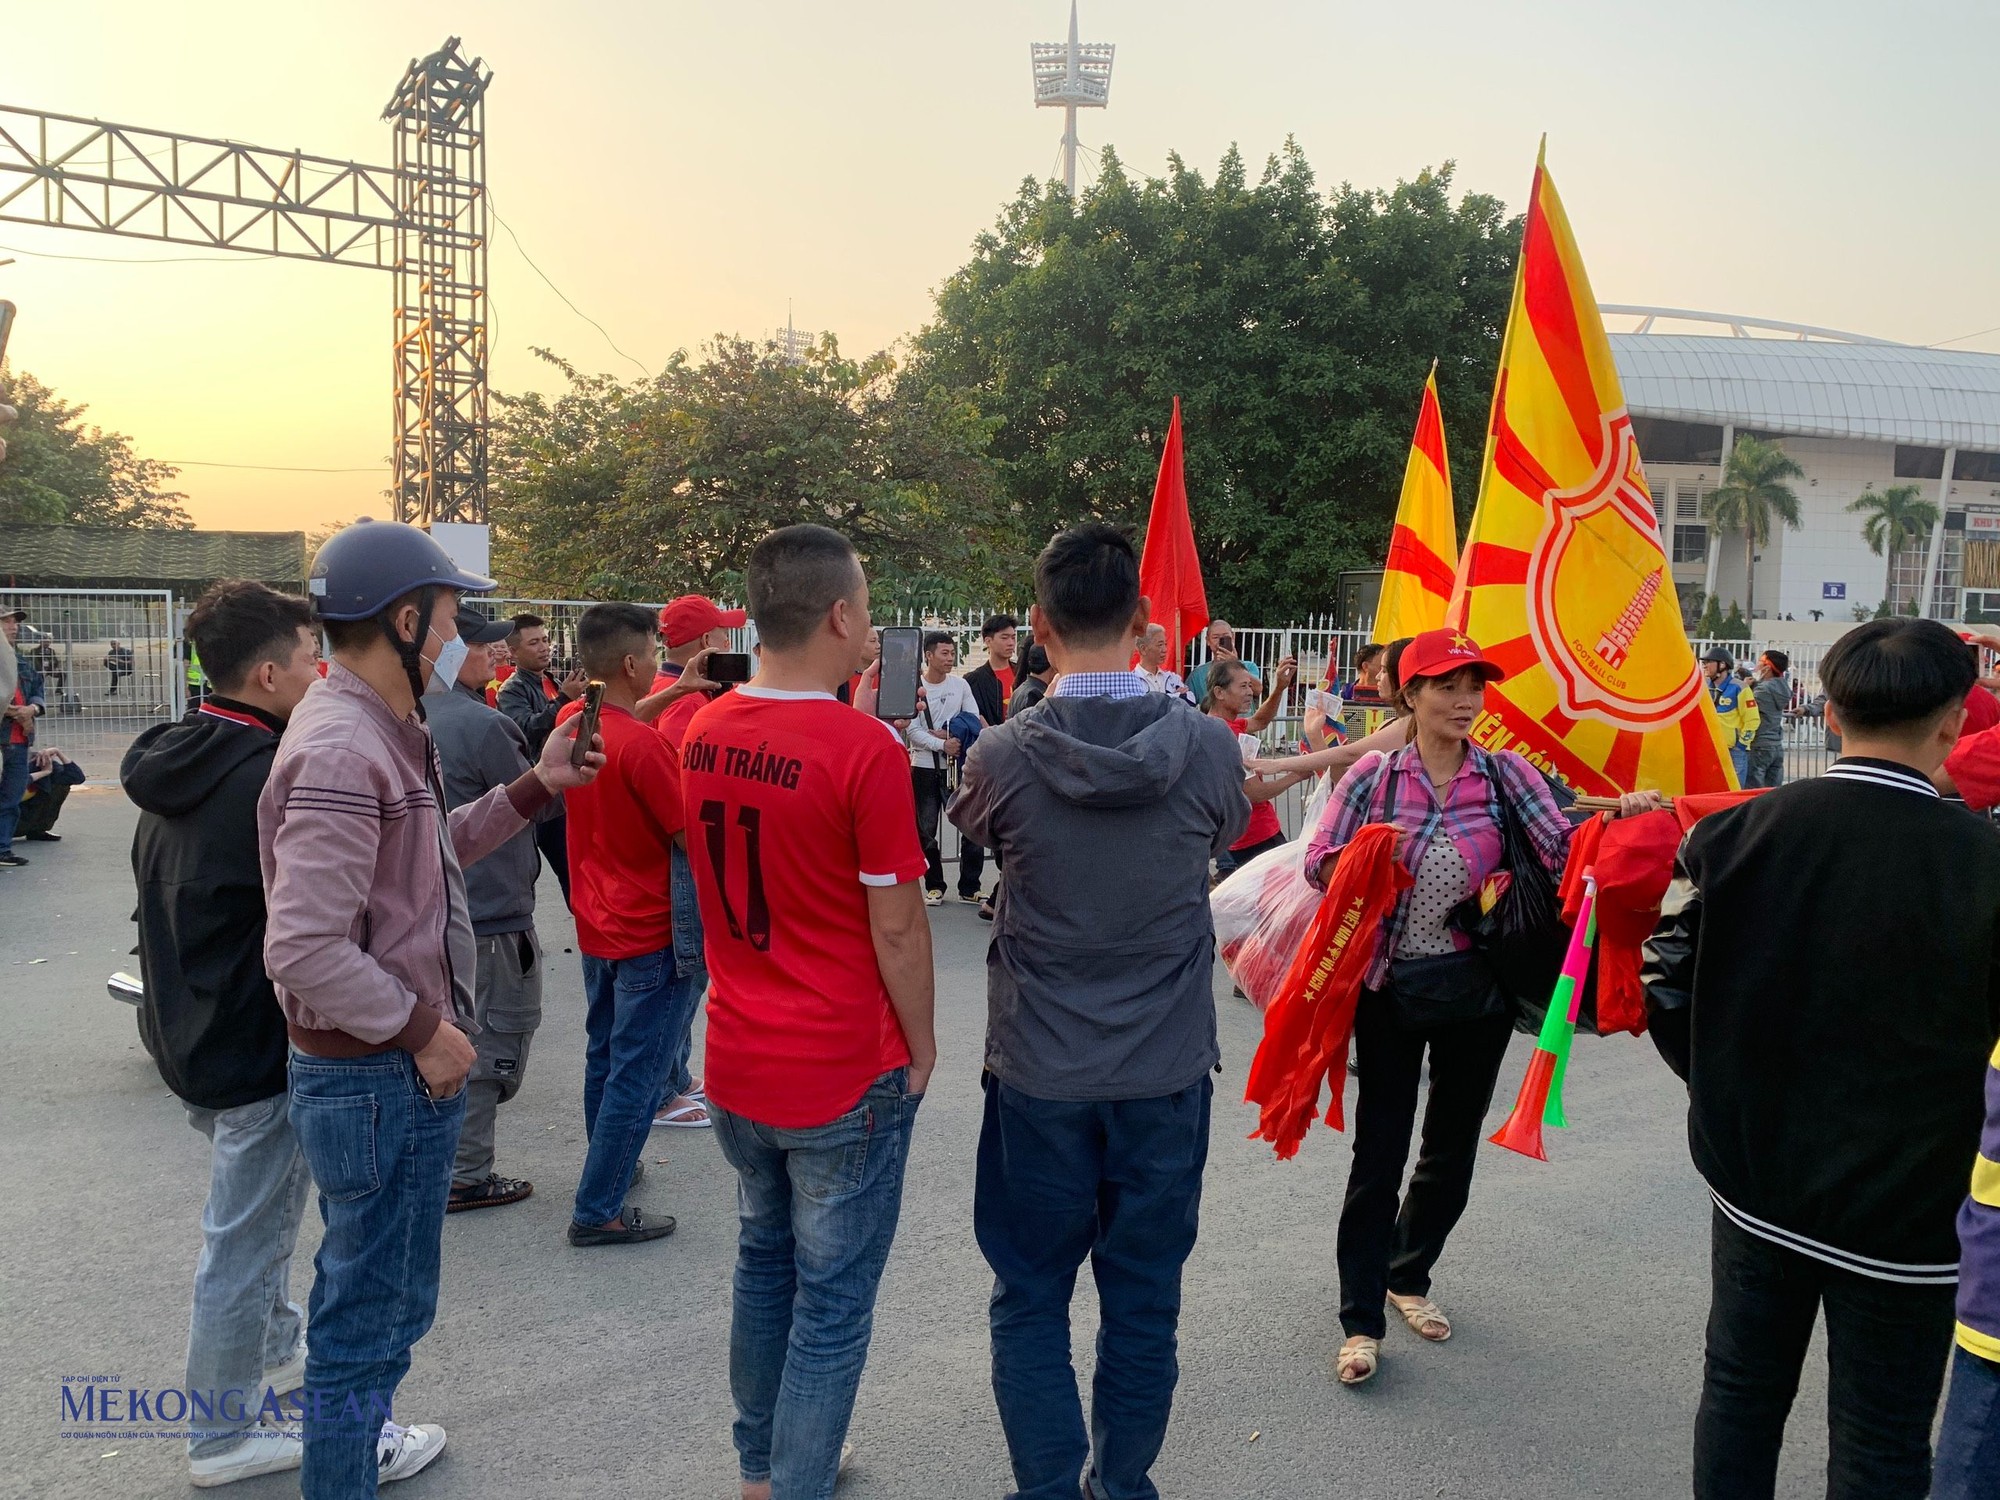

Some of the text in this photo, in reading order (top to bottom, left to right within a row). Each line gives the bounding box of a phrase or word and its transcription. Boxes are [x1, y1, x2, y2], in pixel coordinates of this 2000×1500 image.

[1973, 517, 1993, 528] KHU
[1830, 586, 1838, 597] B
[1572, 638, 1627, 690] FOOTBALL CLUB
[1468, 709, 1516, 754] IÊN
[682, 731, 803, 791] BỐN TRẮNG
[698, 798, 771, 953] 11
[1308, 908, 1362, 992] VIỆT NAM VÔ ĐỊCH
